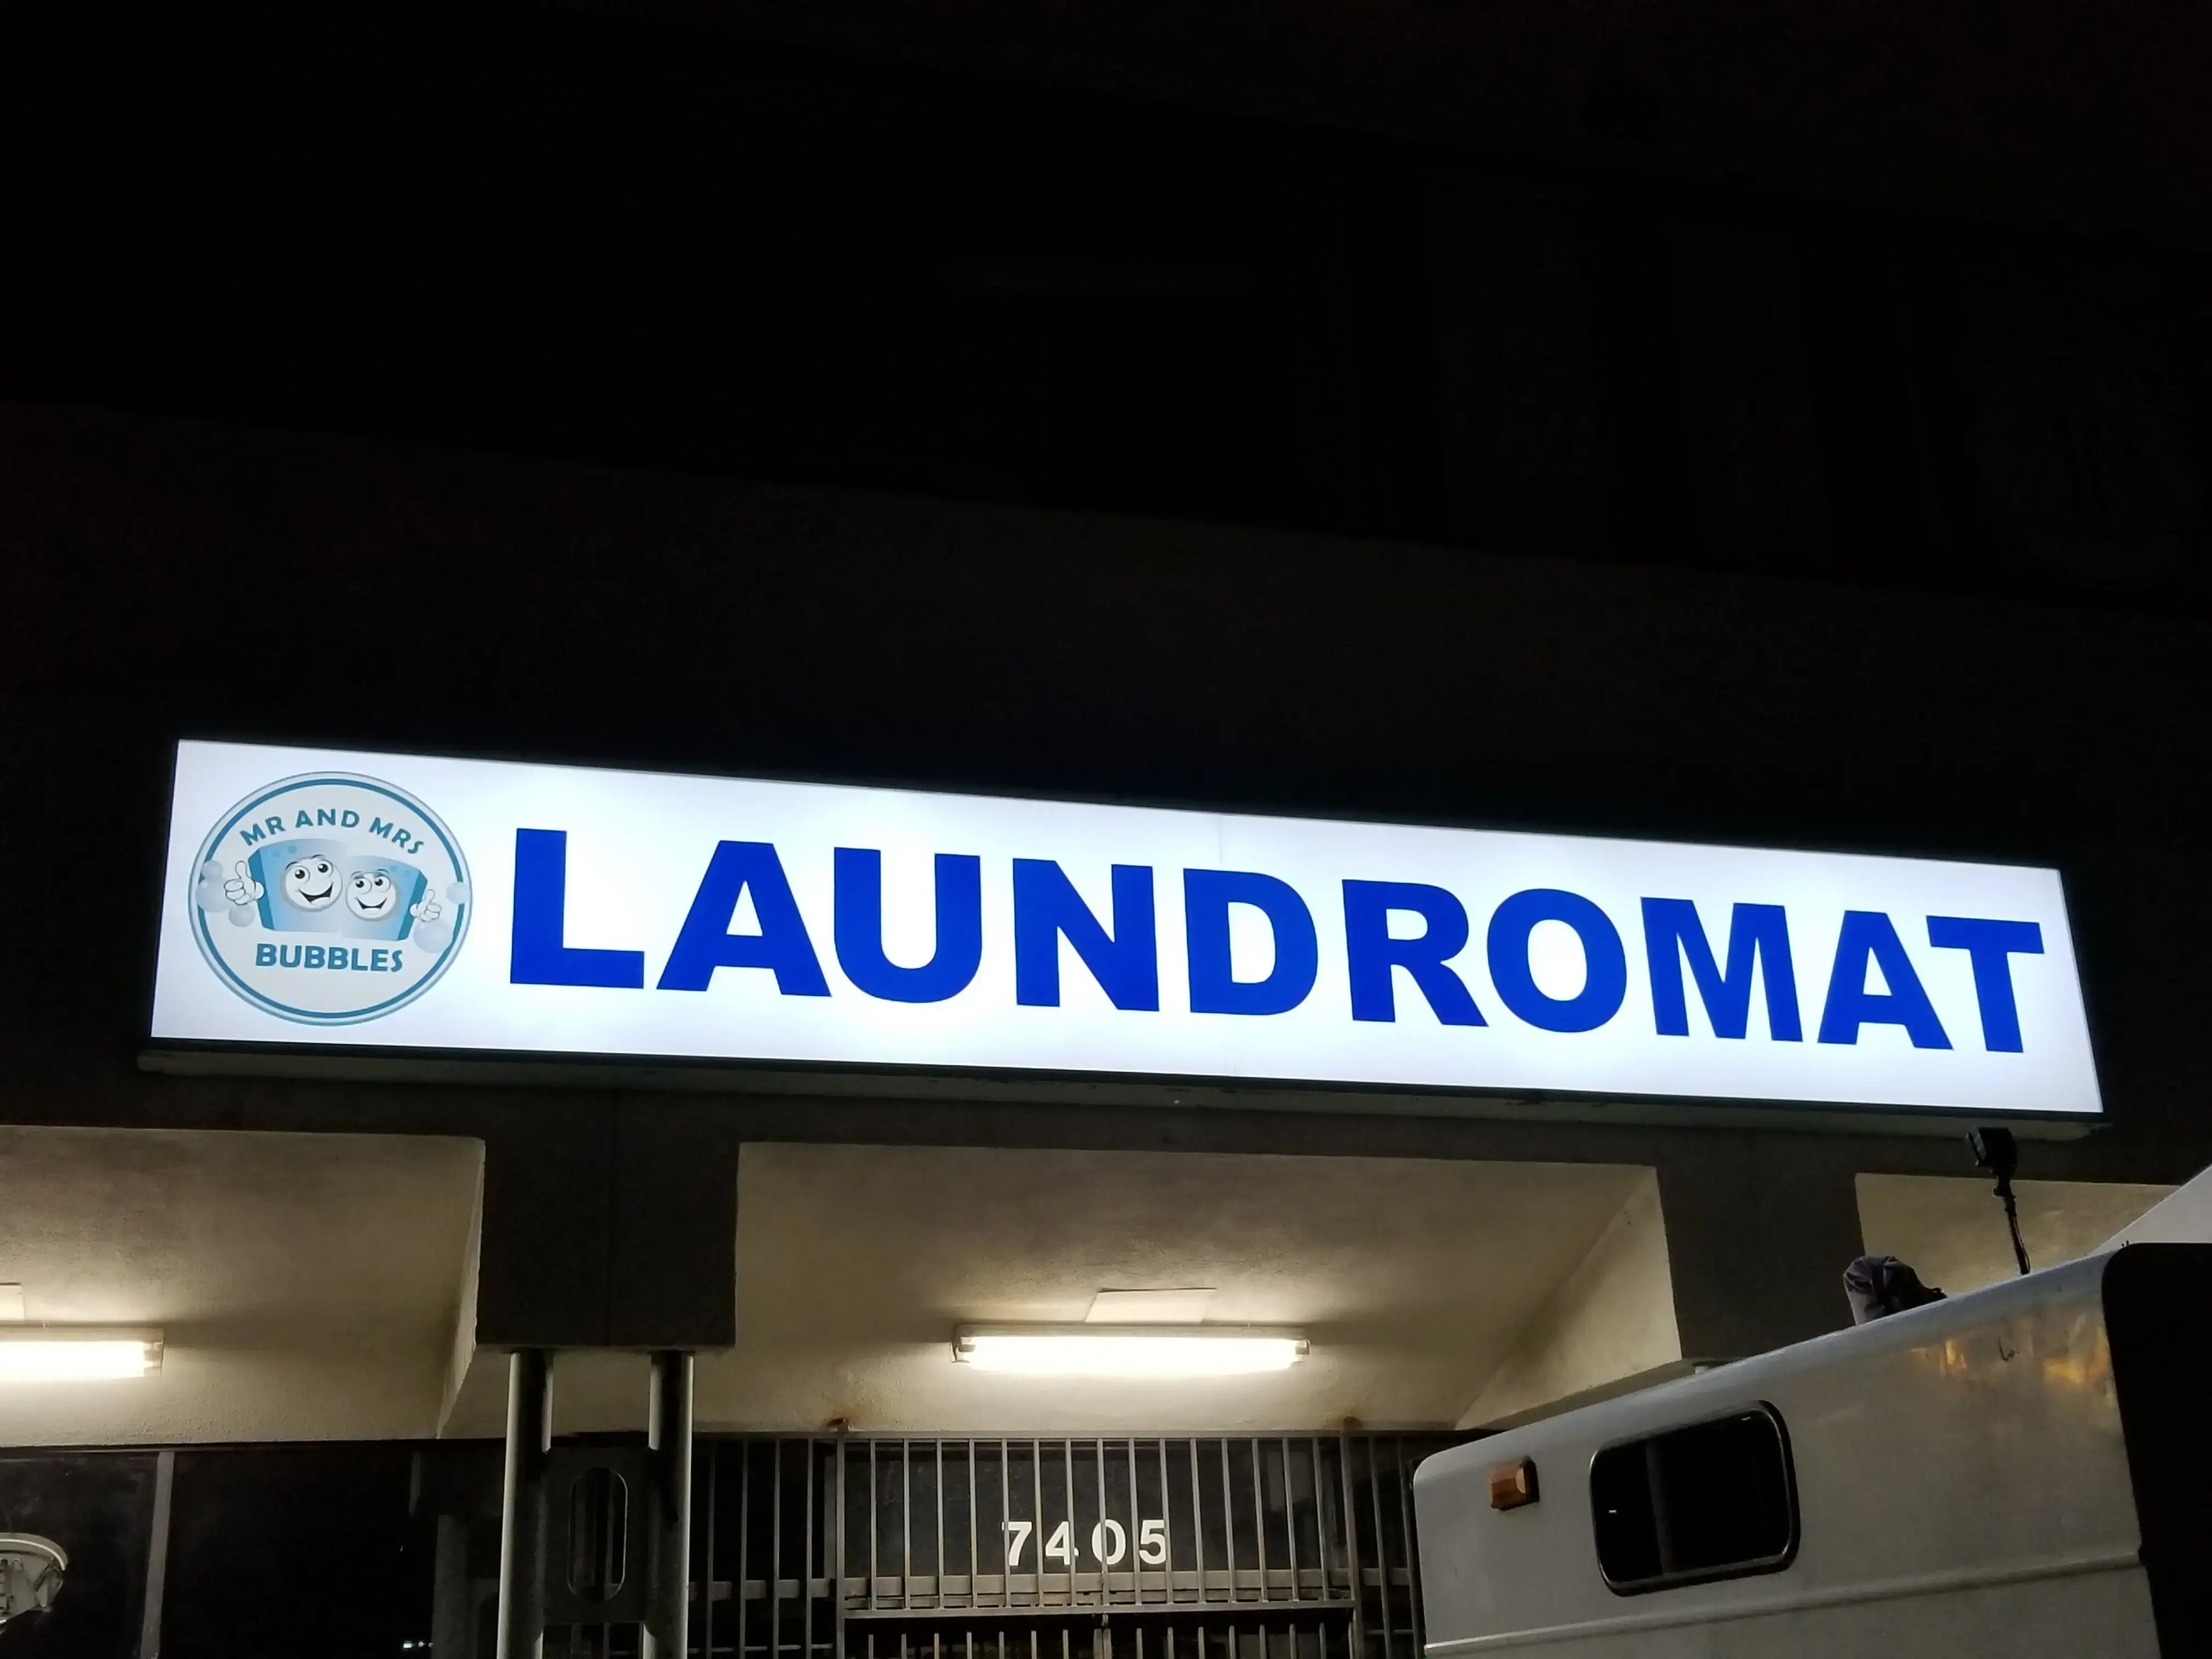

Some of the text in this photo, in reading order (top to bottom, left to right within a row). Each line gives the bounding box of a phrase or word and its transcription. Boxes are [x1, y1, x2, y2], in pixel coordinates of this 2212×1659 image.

[239, 808, 425, 854] MR AND MRS
[255, 943, 403, 973] BUBBLES
[510, 827, 2044, 1053] LAUNDROMAT
[1002, 1519, 1167, 1566] 7405
